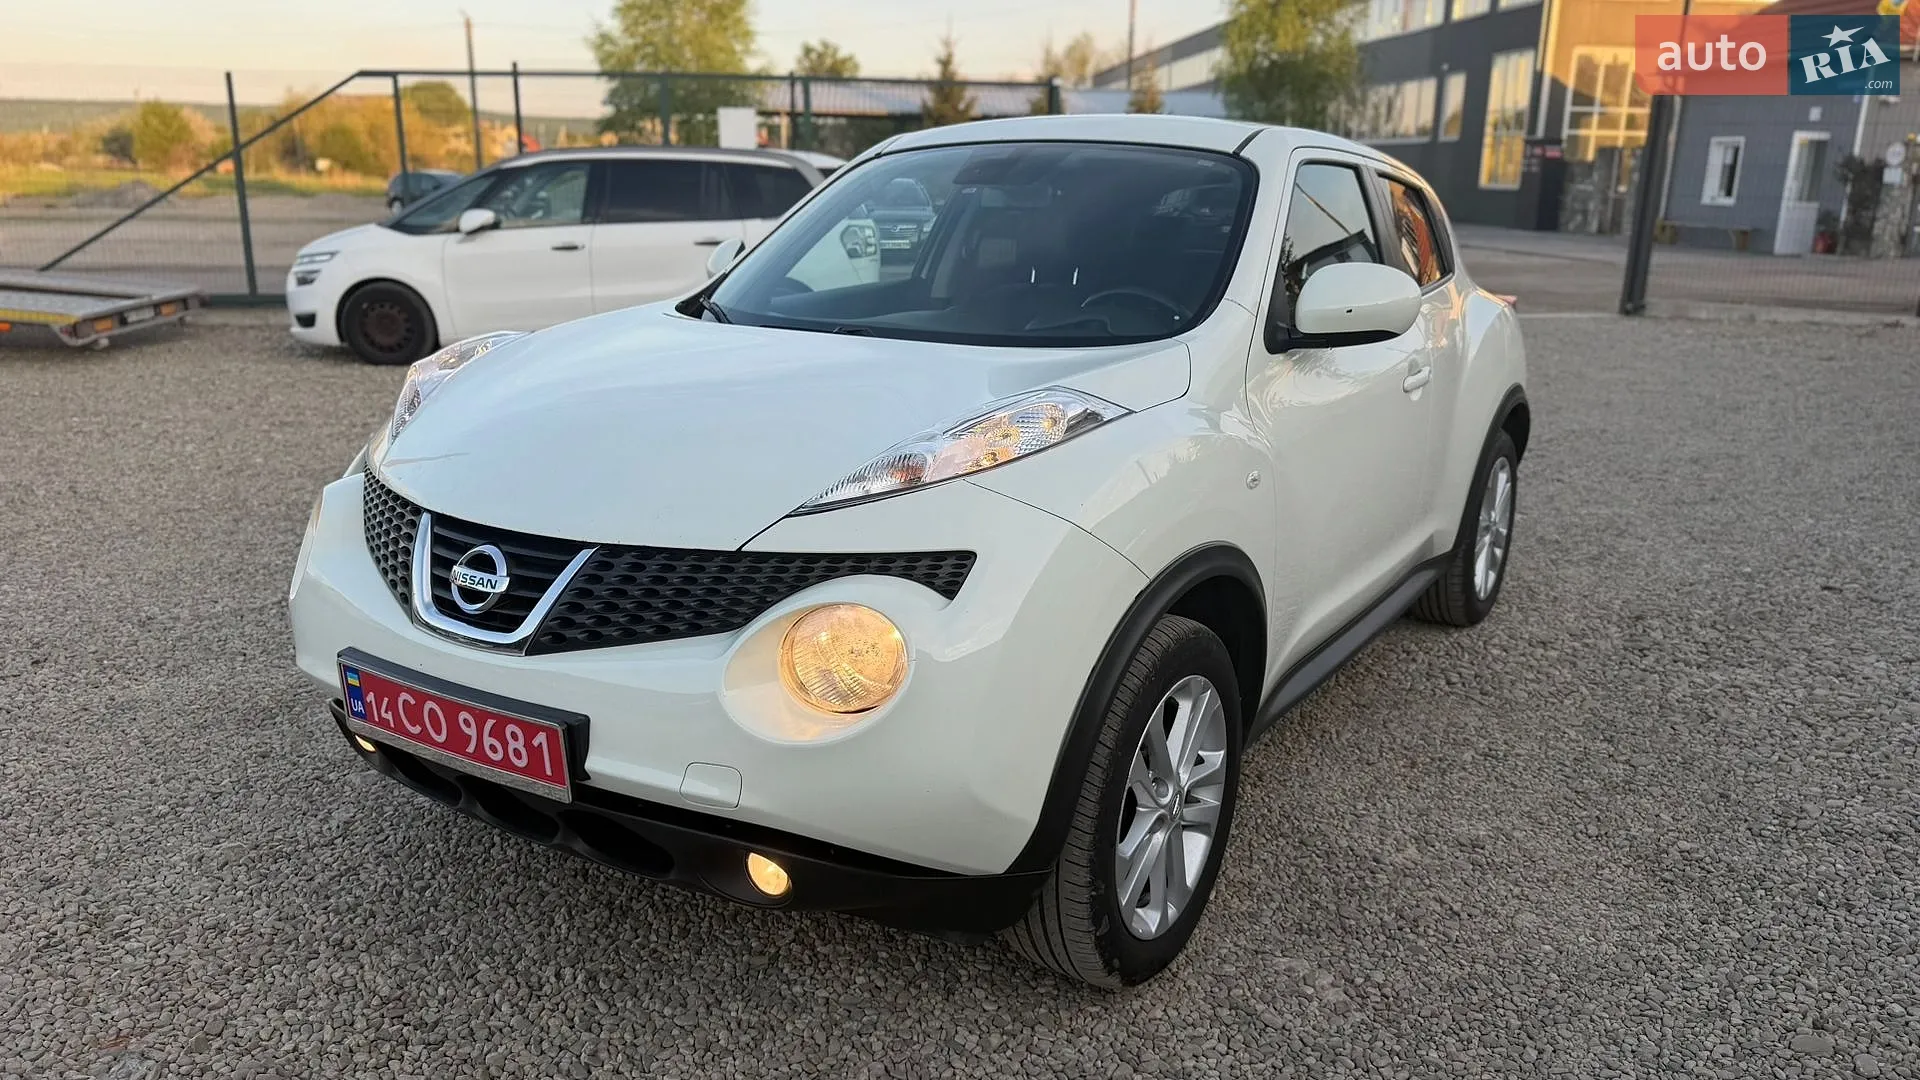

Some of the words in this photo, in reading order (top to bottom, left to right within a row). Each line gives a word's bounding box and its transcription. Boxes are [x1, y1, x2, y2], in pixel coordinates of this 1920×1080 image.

[452, 569, 498, 590] NISSAN
[350, 698, 365, 714] UA
[366, 691, 448, 743] 14CO
[457, 710, 553, 777] 9681
